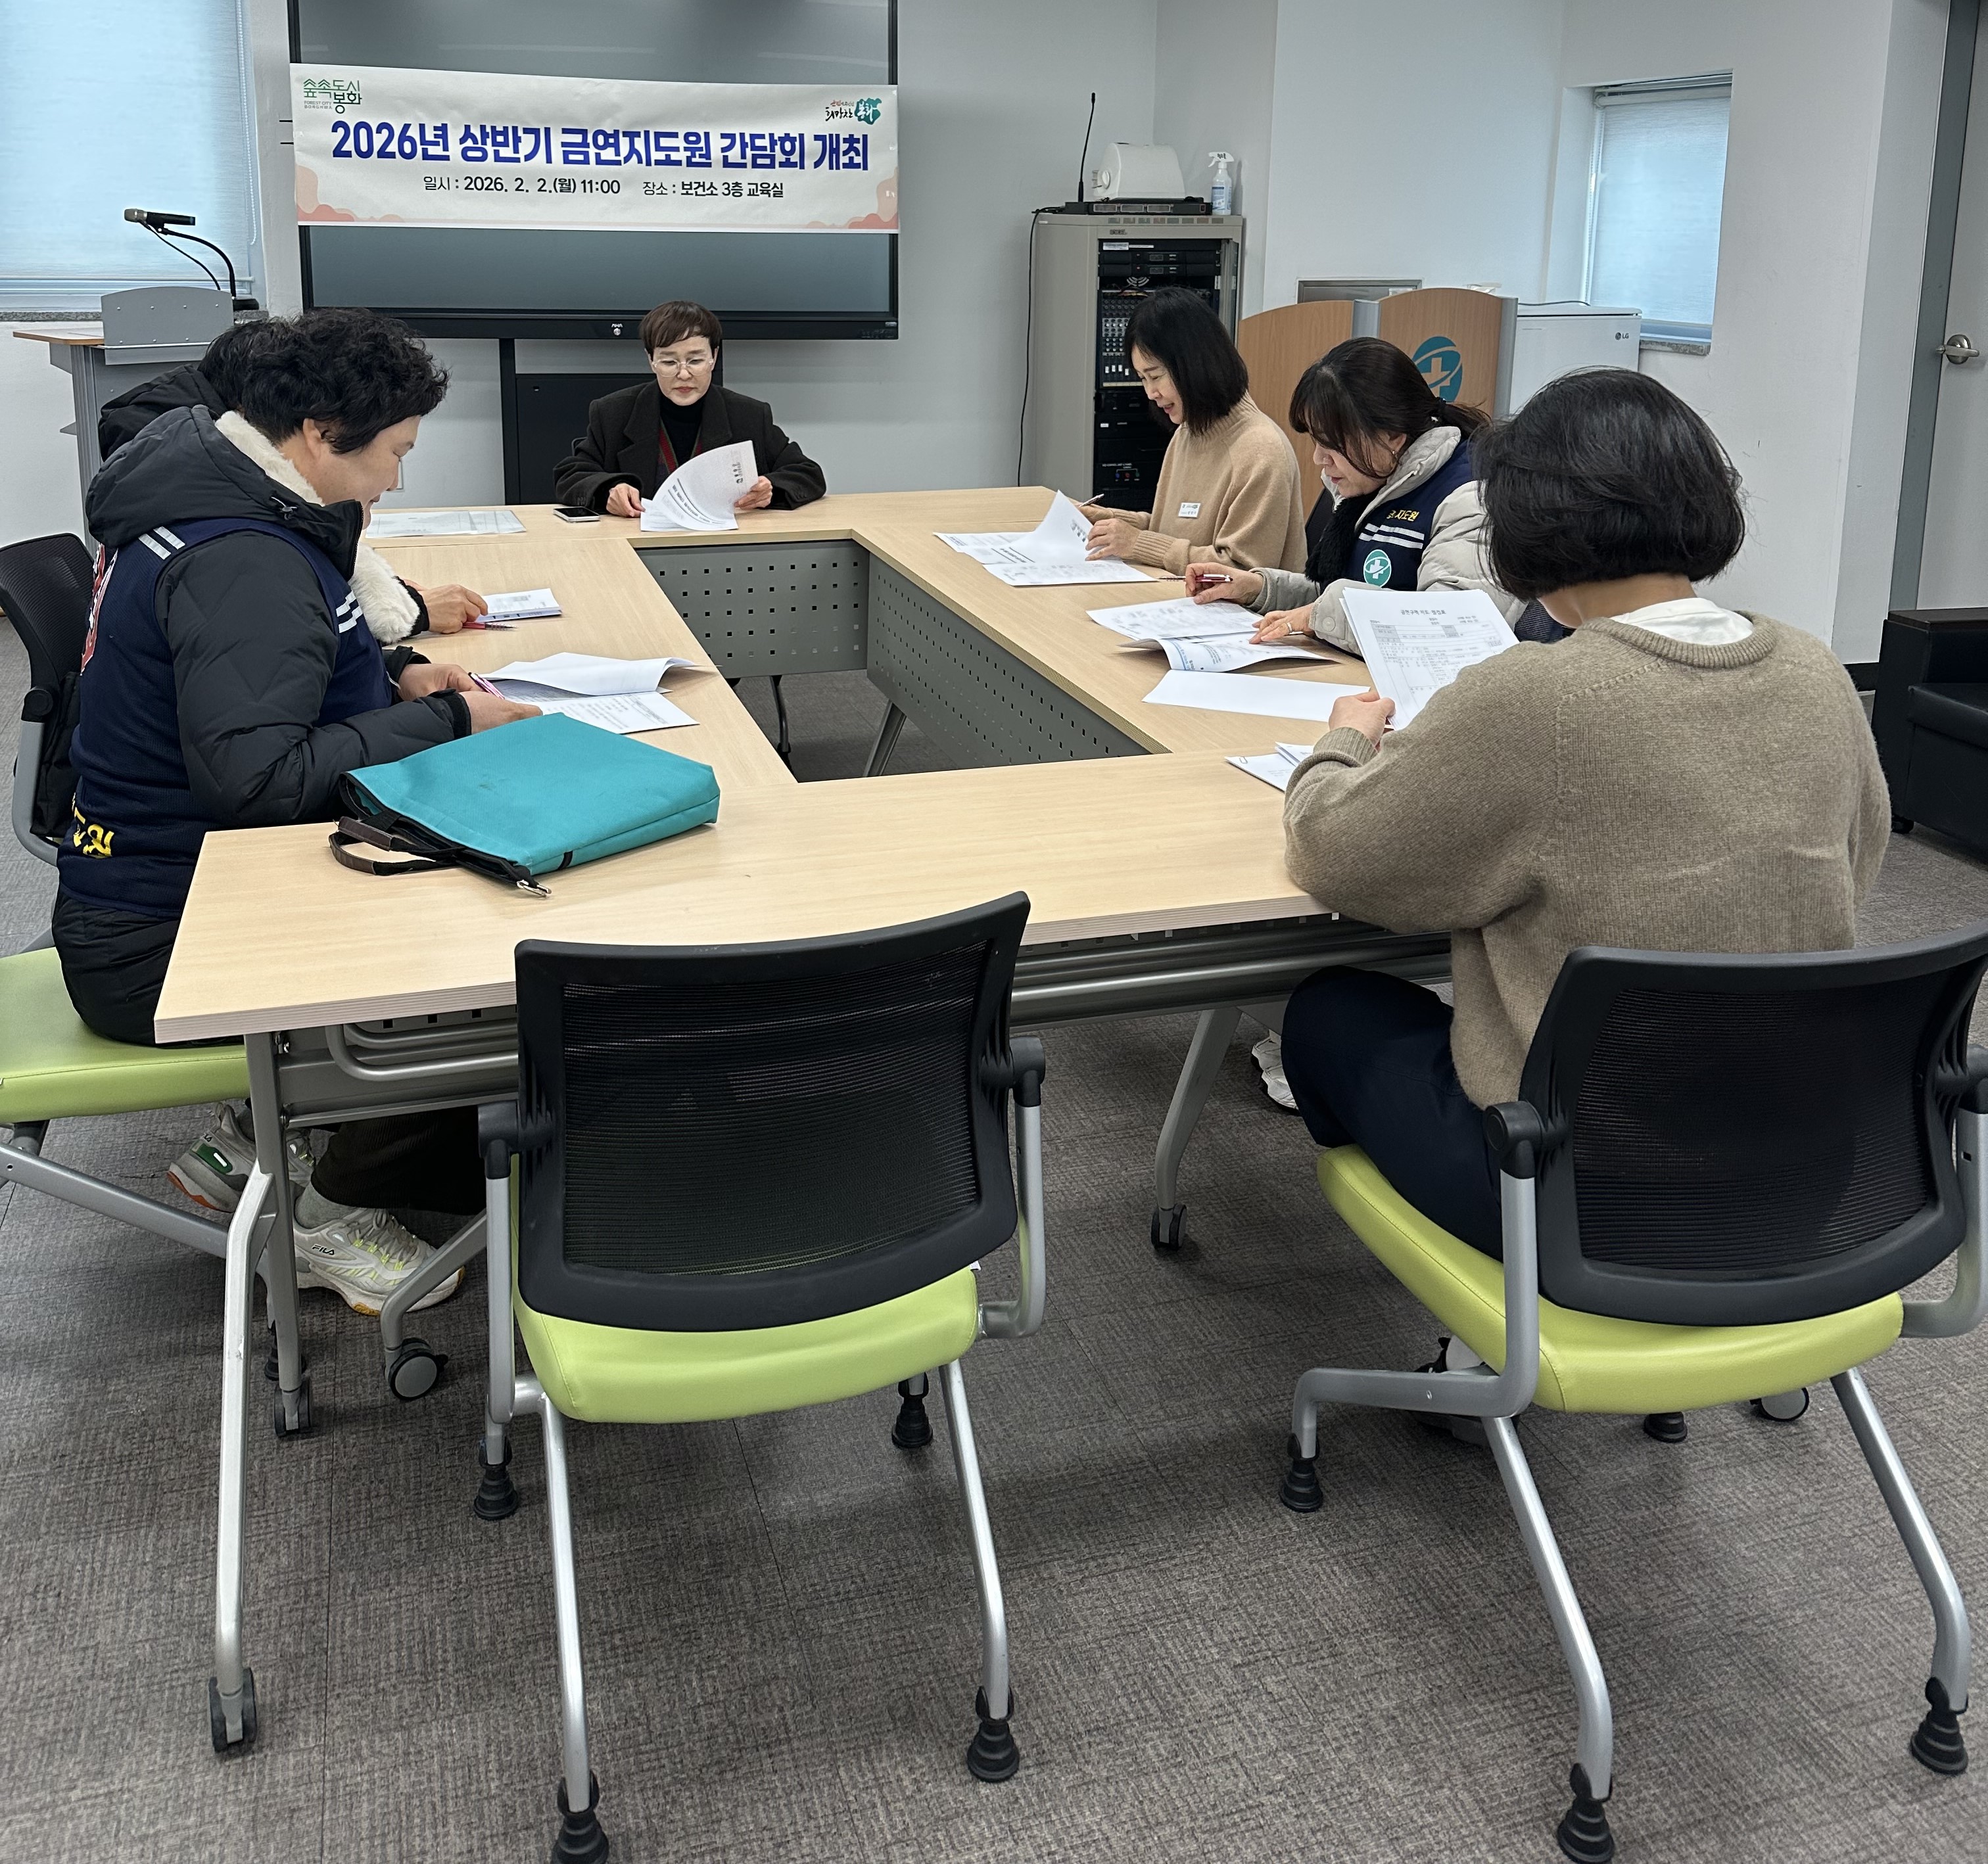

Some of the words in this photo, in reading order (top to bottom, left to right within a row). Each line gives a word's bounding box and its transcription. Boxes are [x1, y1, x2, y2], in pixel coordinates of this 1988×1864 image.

[303, 78, 360, 99] 숲속도시
[333, 91, 363, 114] 봉화
[331, 120, 451, 162] 2026년
[459, 124, 553, 164] 상반기
[560, 127, 713, 168] 금연지도원
[720, 131, 805, 170] 간담회
[813, 133, 868, 171] 개최
[423, 175, 451, 191] 일시
[463, 175, 509, 193] 2026.
[513, 177, 530, 194] 2.
[580, 179, 621, 195] 11:00
[642, 181, 669, 196] 장소
[680, 181, 719, 197] 보건소
[721, 181, 744, 198] 3층
[746, 182, 784, 198] 교육실
[312, 1244, 335, 1256] FILA
